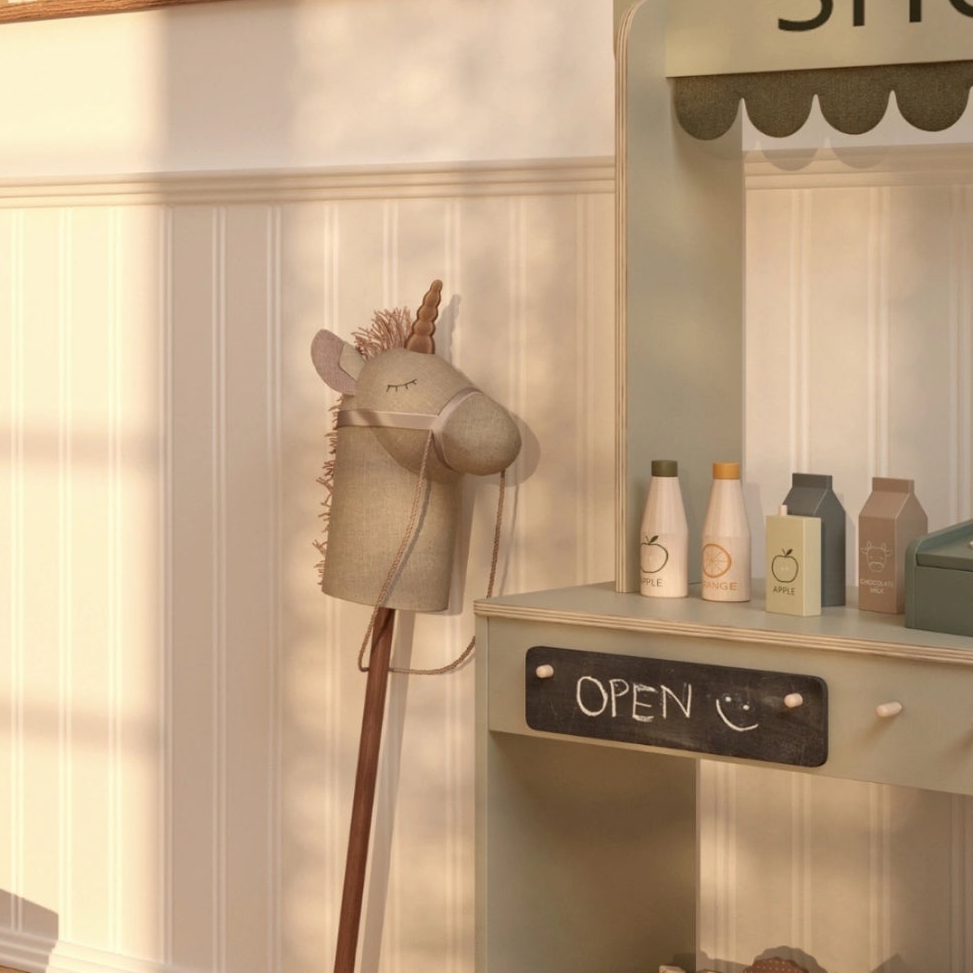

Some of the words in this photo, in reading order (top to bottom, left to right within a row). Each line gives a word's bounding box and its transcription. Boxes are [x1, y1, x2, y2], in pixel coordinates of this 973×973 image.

[641, 577, 664, 587] PPLE
[772, 586, 796, 596] APPLE
[577, 675, 693, 723] OPEN
